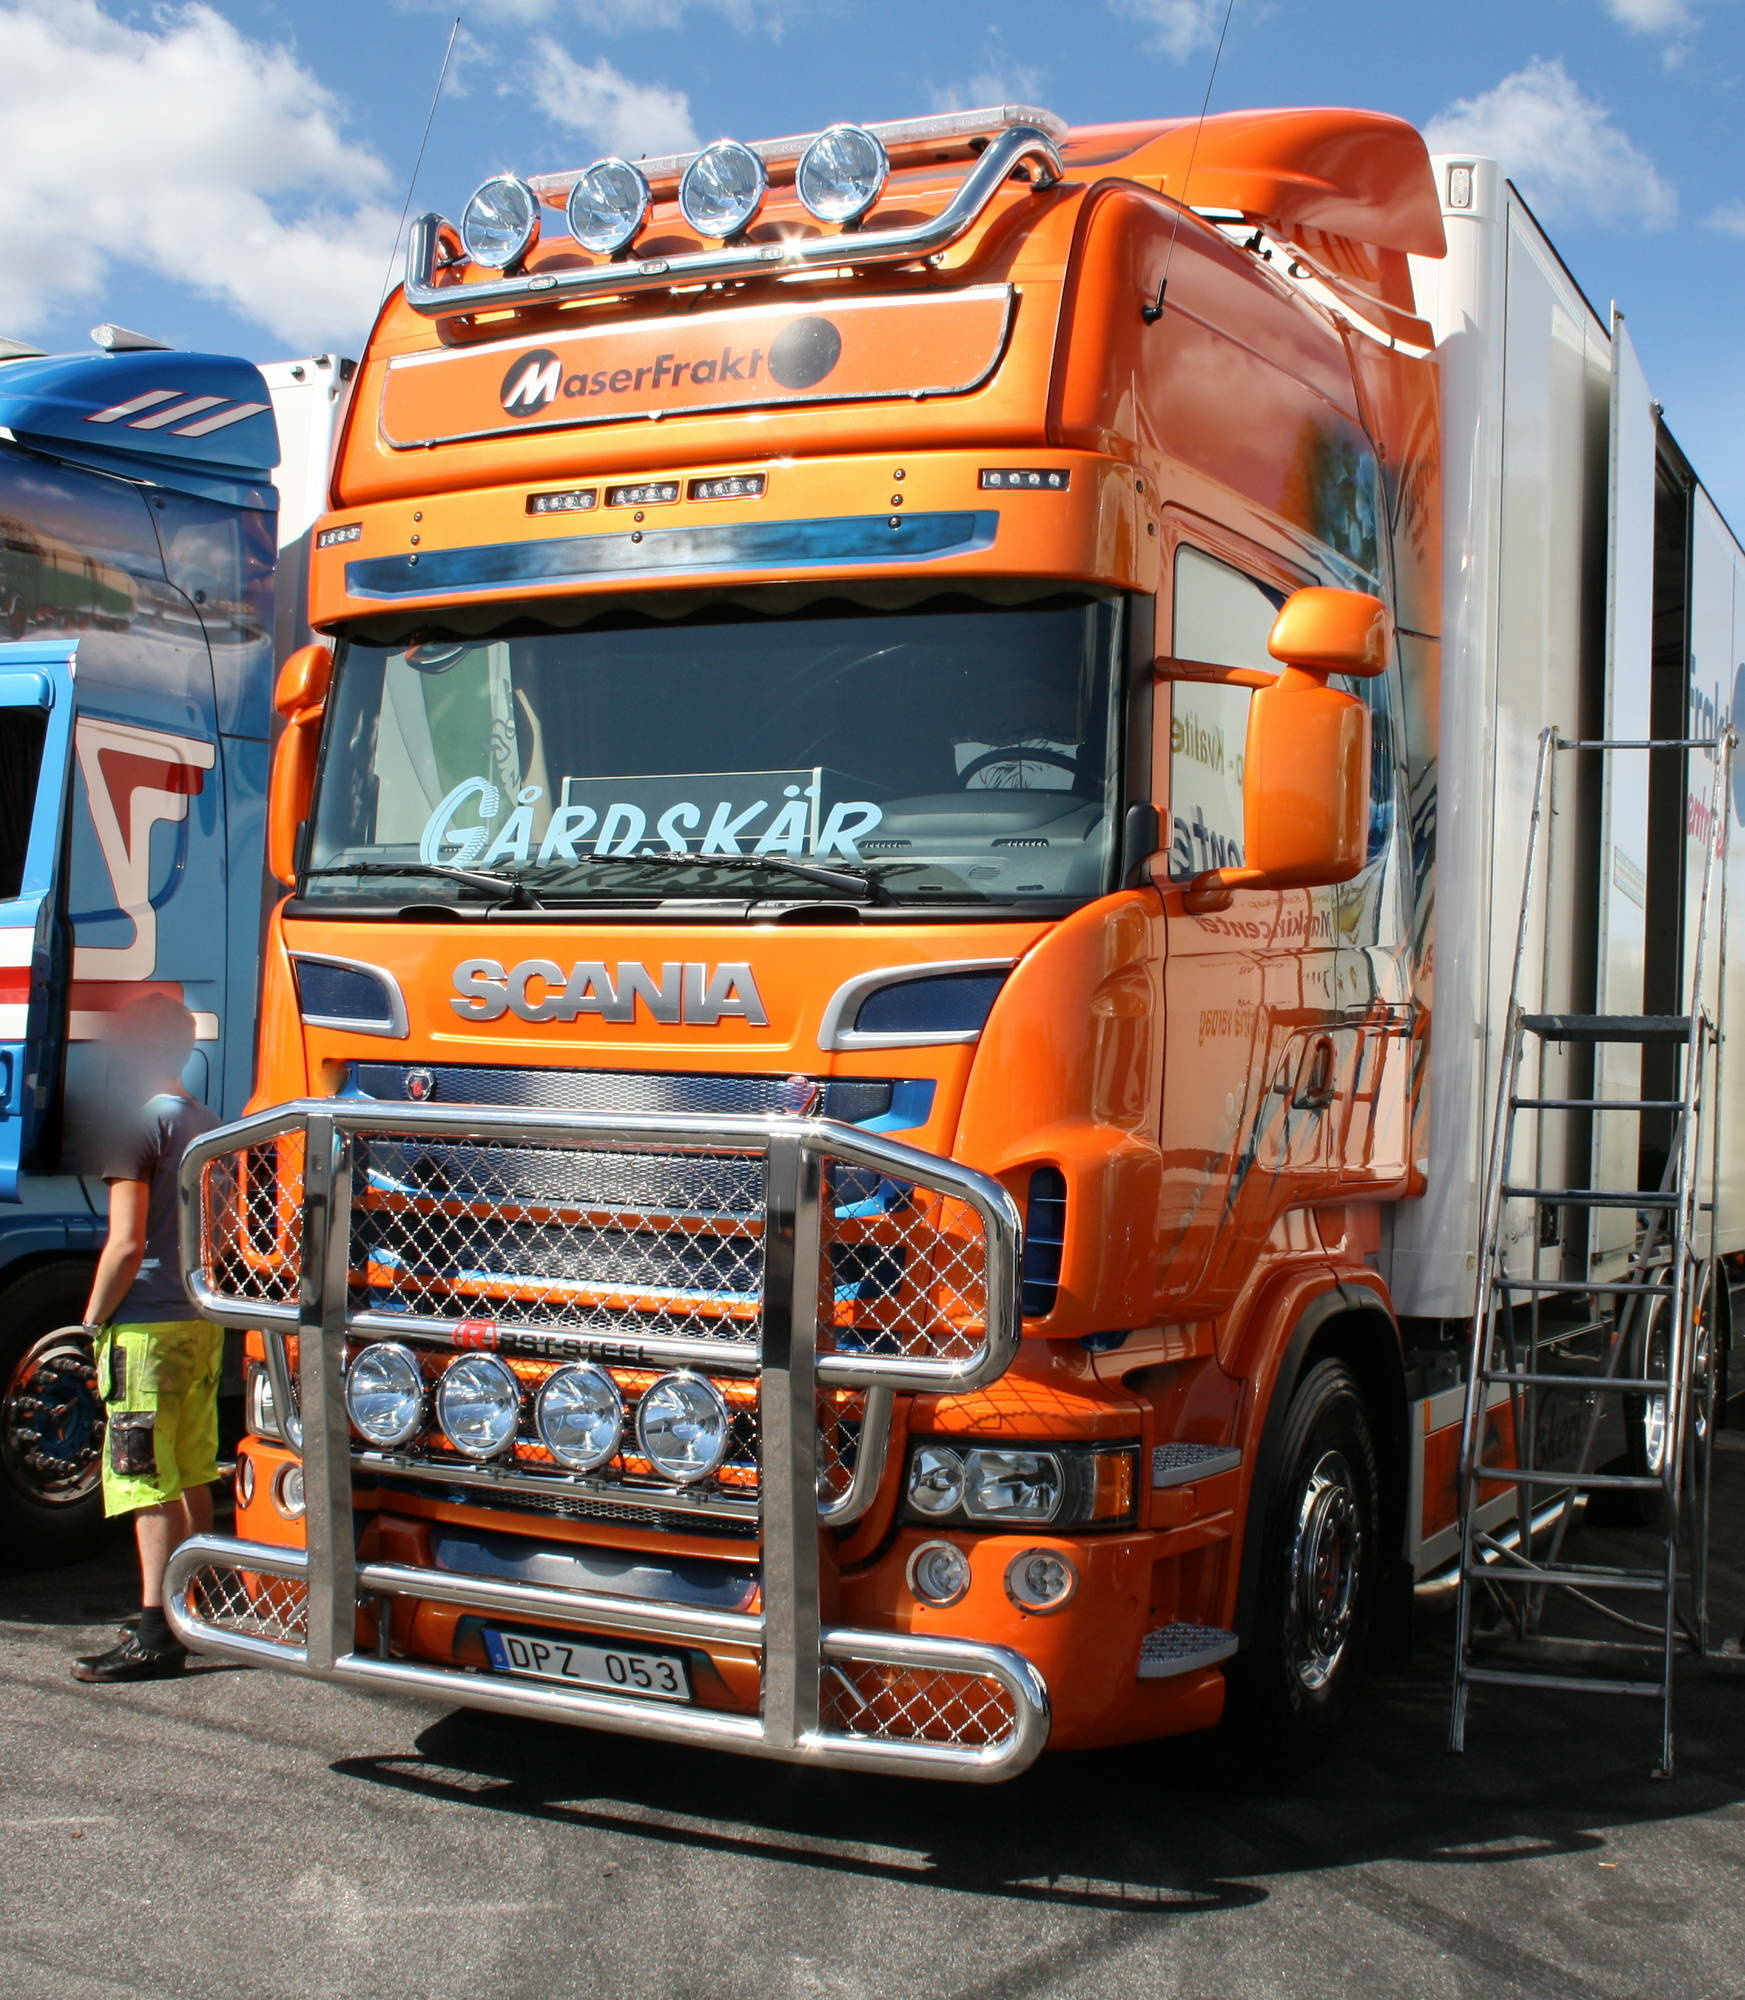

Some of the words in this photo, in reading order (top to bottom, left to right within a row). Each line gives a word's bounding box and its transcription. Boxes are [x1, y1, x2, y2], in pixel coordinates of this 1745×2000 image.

[502, 347, 765, 409] MaserFrakt
[420, 776, 883, 870] GÅRDSKÄR
[450, 958, 770, 1027] SCANIA
[507, 1637, 581, 1677] DPZ
[605, 1653, 679, 1692] 053
